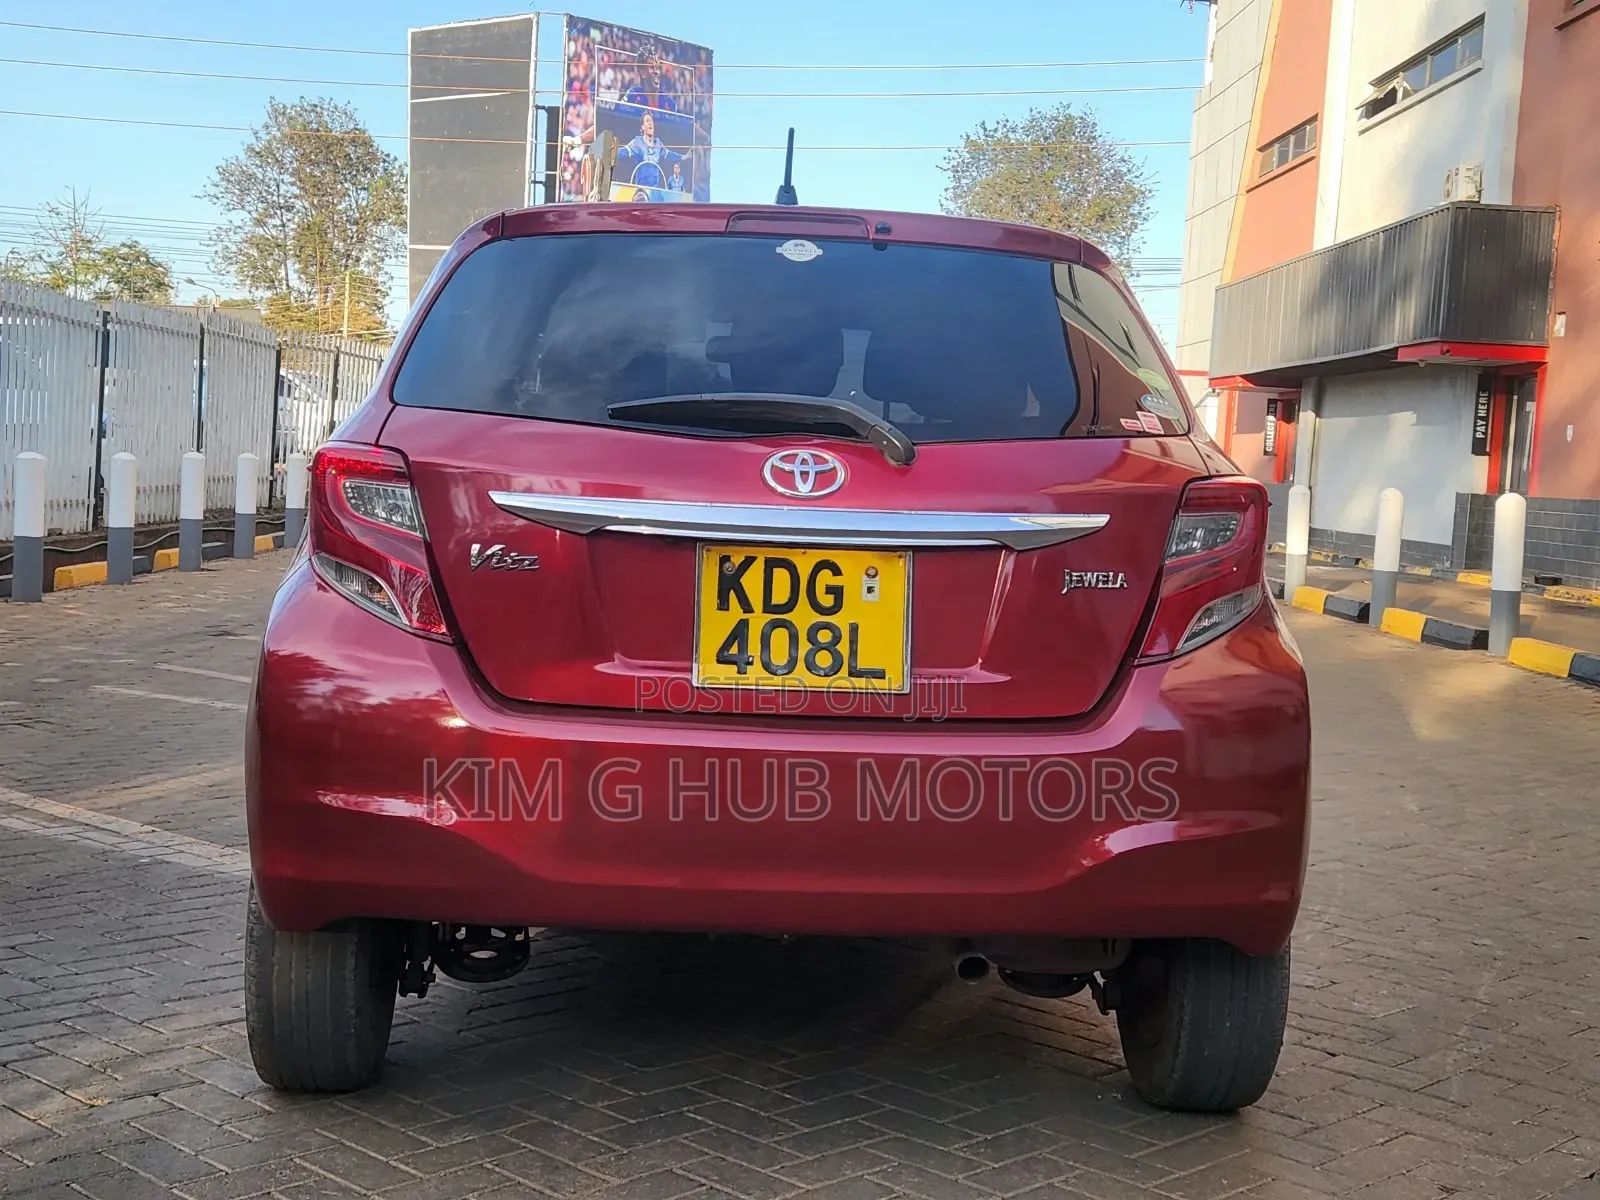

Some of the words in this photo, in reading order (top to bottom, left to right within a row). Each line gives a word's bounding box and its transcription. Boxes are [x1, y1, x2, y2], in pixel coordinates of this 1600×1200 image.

[1478, 391, 1489, 417] HERE
[1265, 420, 1275, 452] COLLECT
[1475, 420, 1487, 438] PAY
[470, 543, 539, 571] Vitz
[717, 554, 845, 616] KDG
[1061, 569, 1128, 594] JEWELA
[716, 617, 886, 679] 408L
